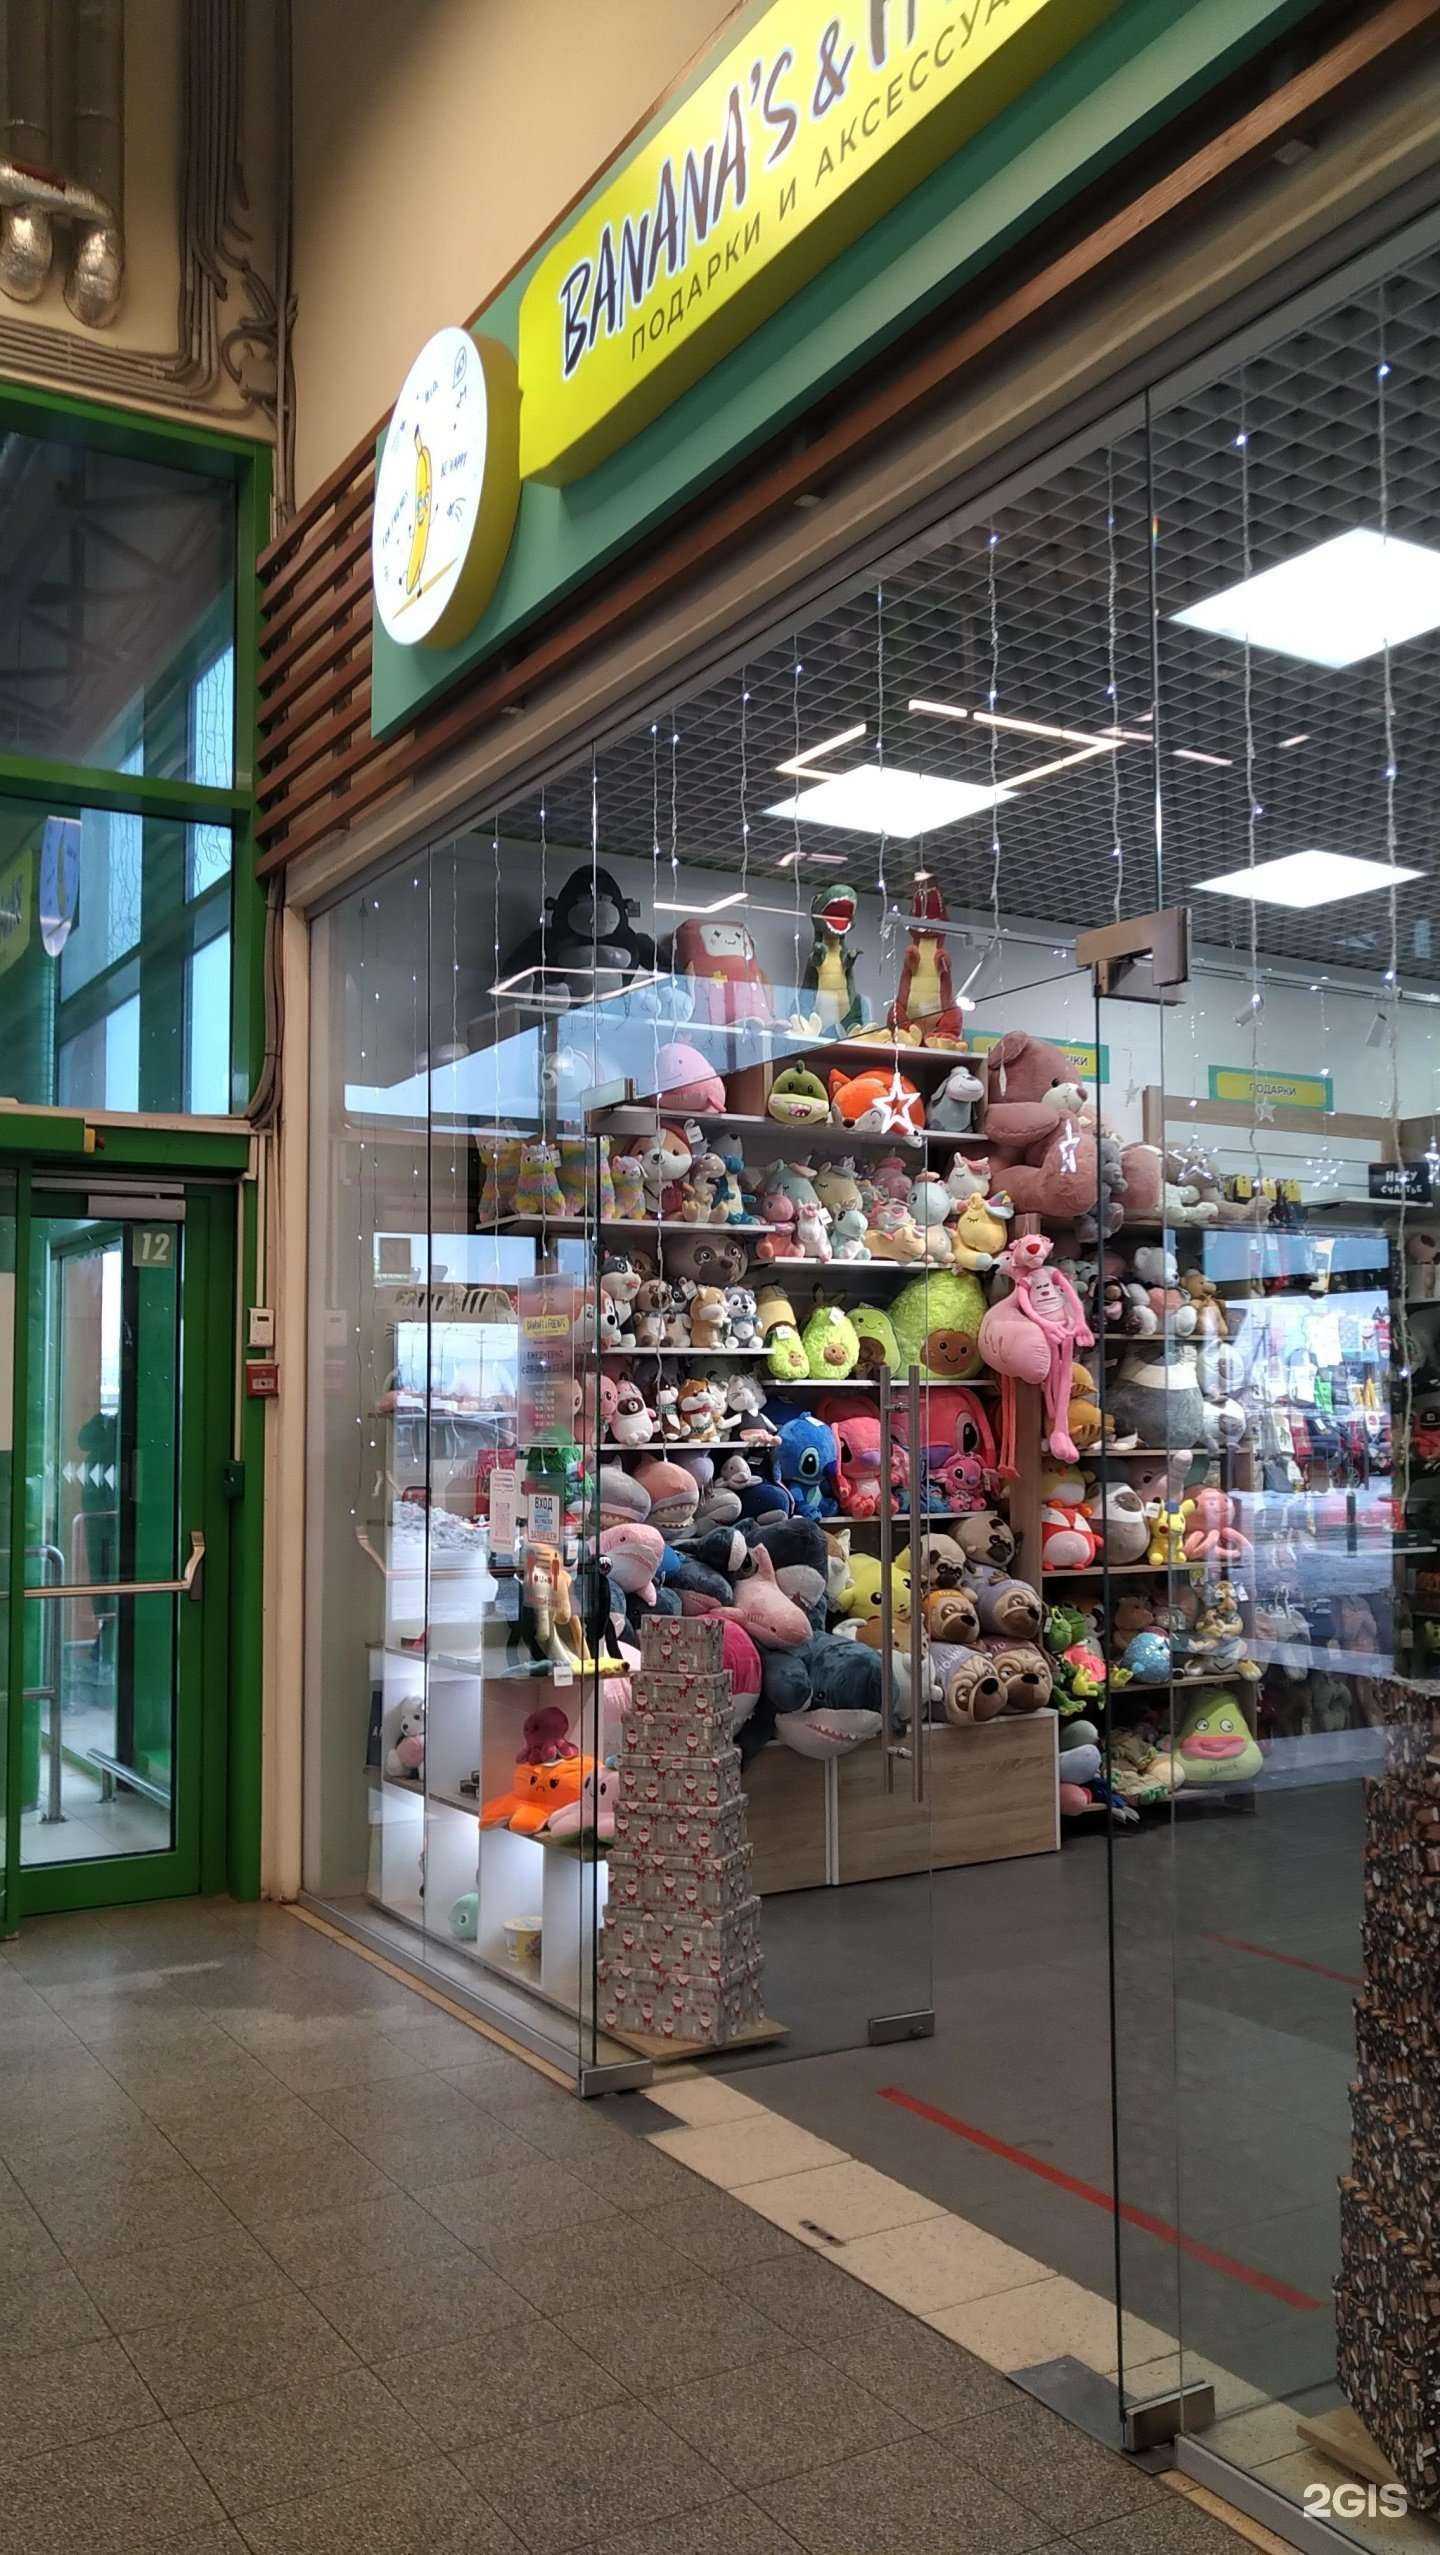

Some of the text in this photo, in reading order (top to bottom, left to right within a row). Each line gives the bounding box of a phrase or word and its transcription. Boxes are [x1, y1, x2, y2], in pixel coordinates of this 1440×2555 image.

[561, 19, 854, 376] BANANA'S &
[632, 211, 761, 361] ПОДАРКИ
[779, 177, 797, 222] И
[1248, 1082, 1297, 1096] ПОДАРКИ
[141, 1232, 170, 1261] 12
[534, 1496, 553, 1512] ВХОД
